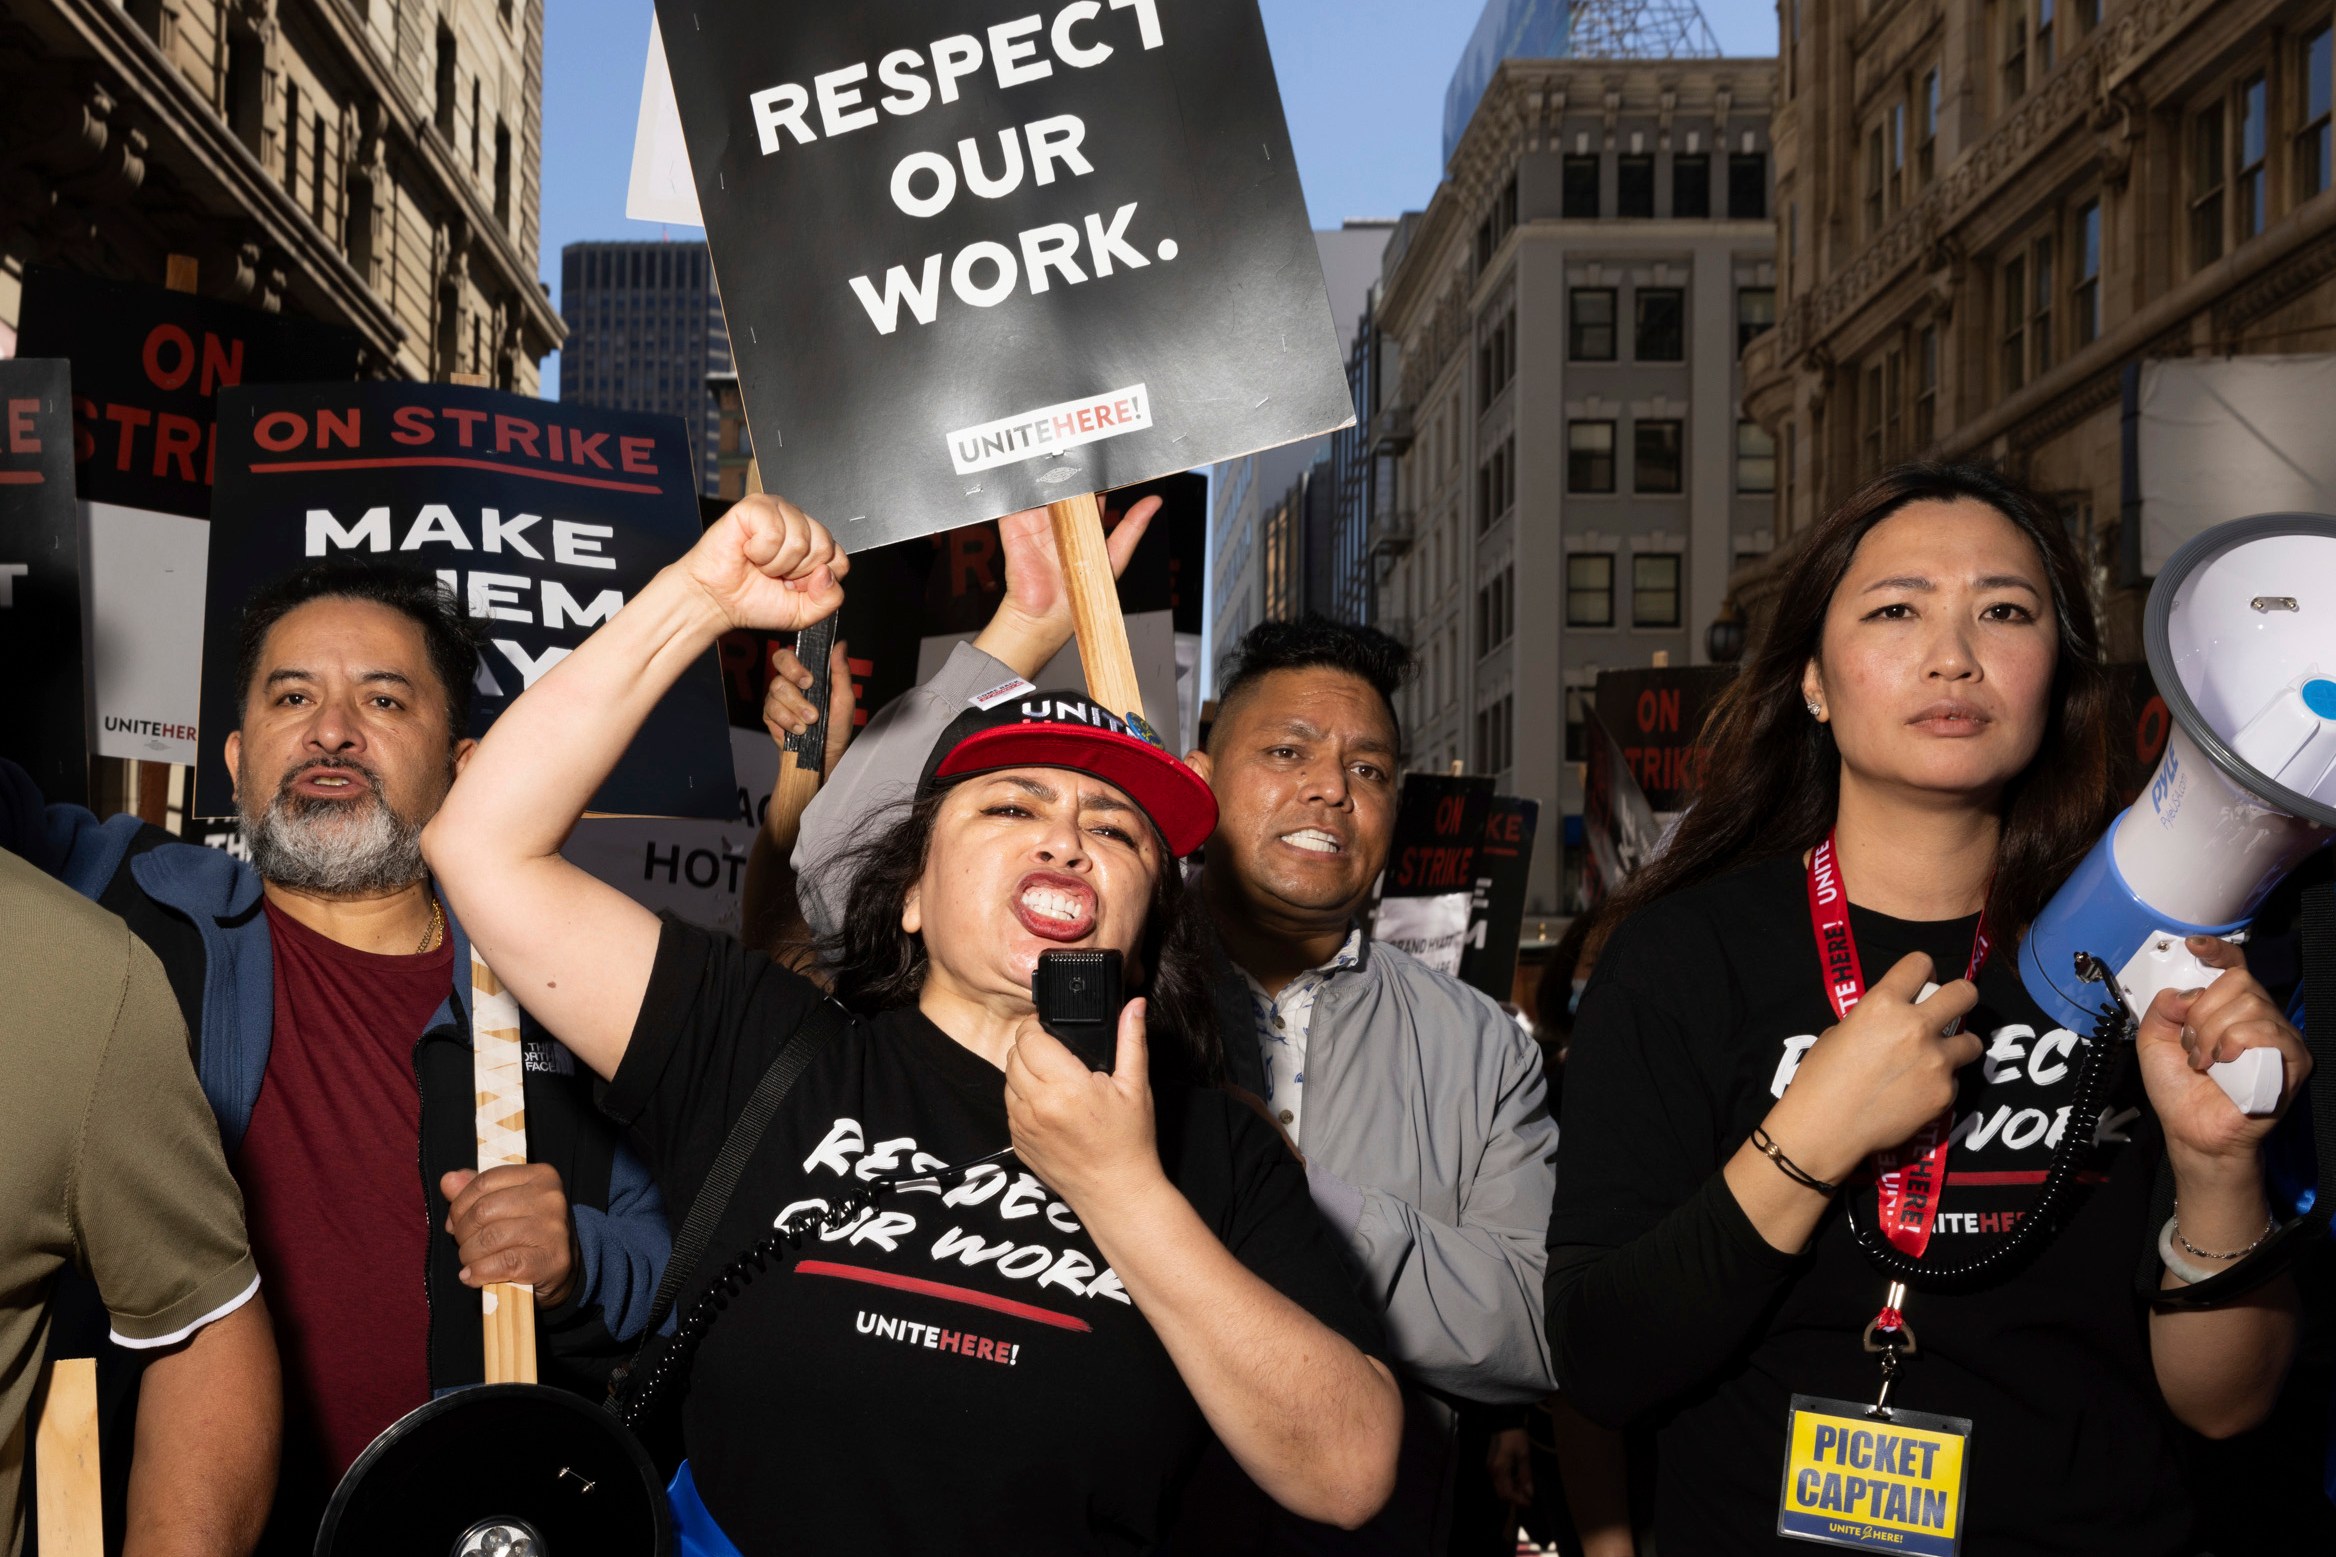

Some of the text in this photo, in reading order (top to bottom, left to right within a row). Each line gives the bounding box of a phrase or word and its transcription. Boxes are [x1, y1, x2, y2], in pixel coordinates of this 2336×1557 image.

[750, 0, 1164, 156] RESPECT
[890, 114, 1094, 217] OUR
[849, 202, 1180, 335] WORK.
[142, 323, 244, 397] ON
[253, 406, 659, 476] ON STRIKE
[957, 397, 1143, 464] UNITEHERE!
[305, 504, 617, 570] MAKE
[1637, 688, 1681, 733] ON
[2151, 740, 2179, 815] PYLE
[1435, 795, 1465, 837] ON
[644, 841, 747, 893] HOT
[1397, 846, 1474, 888] STRIKE
[1813, 839, 1837, 906] UNITE
[1822, 920, 1860, 1018] TEHERE!
[931, 1226, 1132, 1306] WORK
[855, 1311, 1020, 1366] UNITEHERE!
[1813, 1424, 1941, 1480] PICKET
[1796, 1468, 1948, 1529] CAPTAIN
[1829, 1523, 1904, 1544] UNITE HERE!
